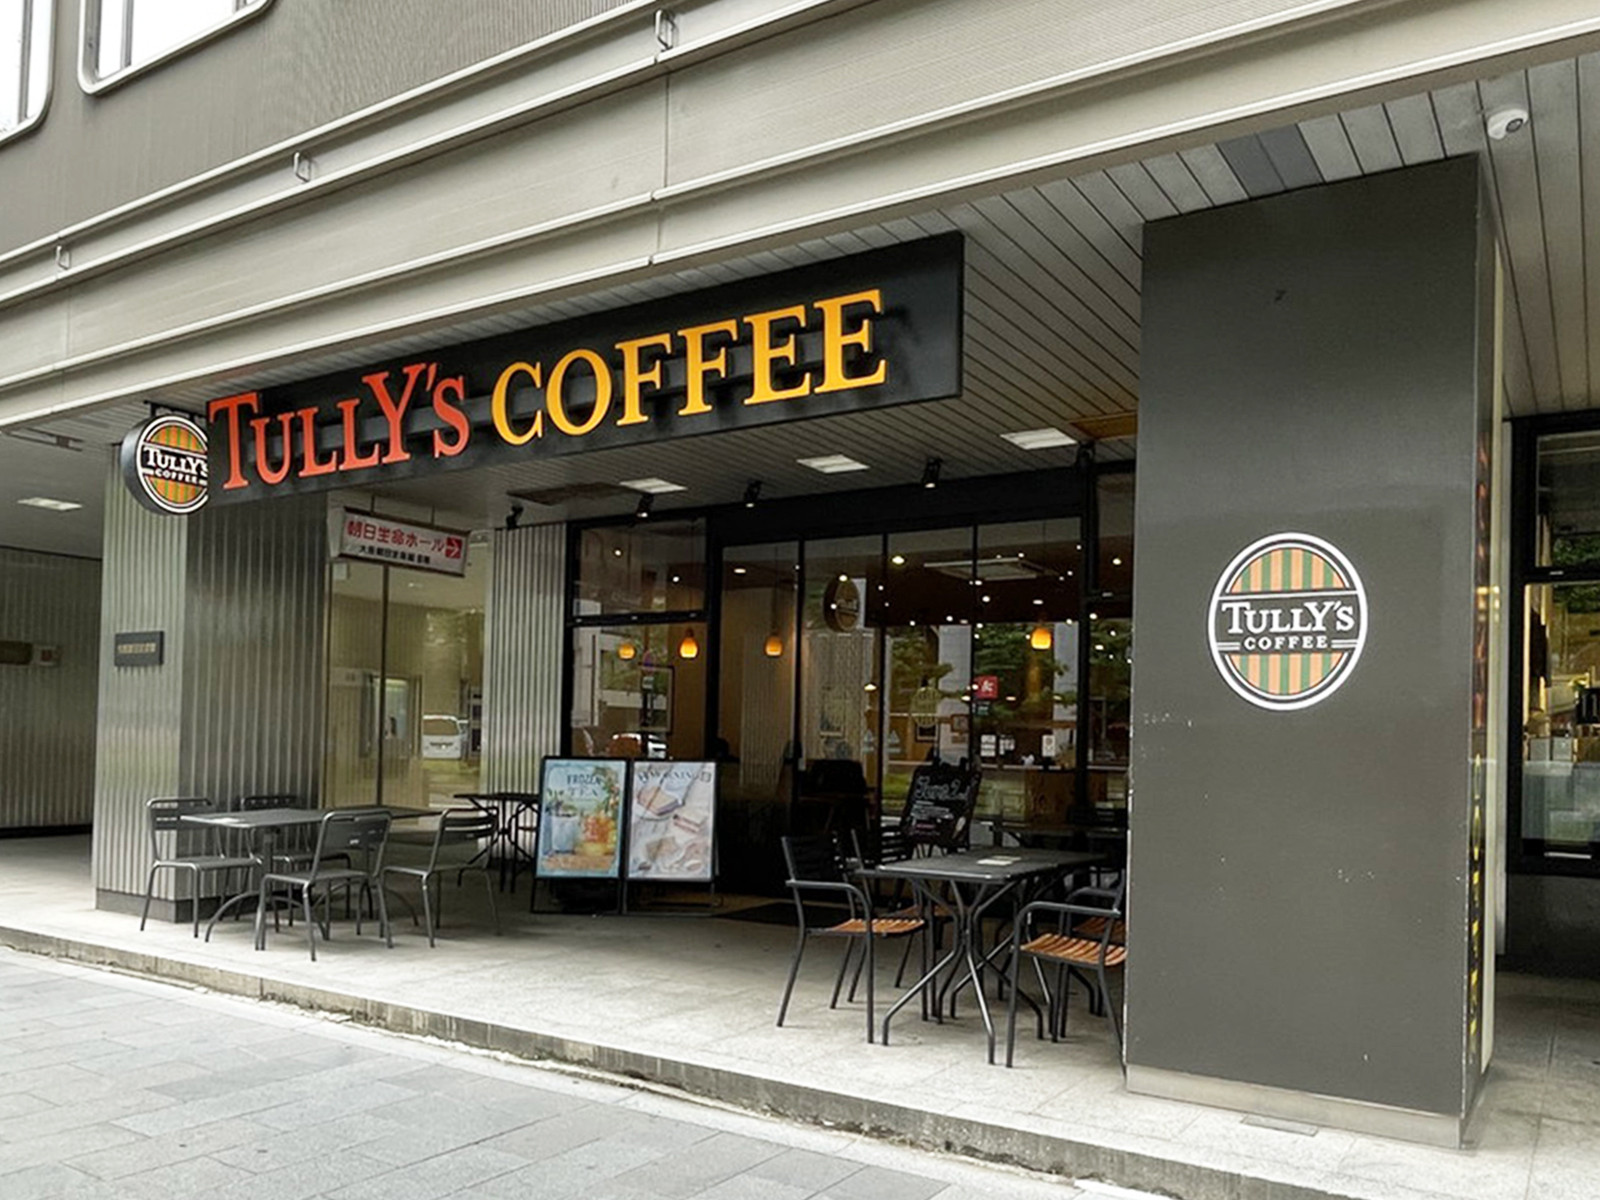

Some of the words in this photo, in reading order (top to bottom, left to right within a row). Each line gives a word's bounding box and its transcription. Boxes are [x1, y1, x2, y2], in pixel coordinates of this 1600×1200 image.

[490, 288, 889, 446] COFFEE
[154, 468, 198, 484] COFFEE
[1243, 635, 1328, 650] COFFEE
